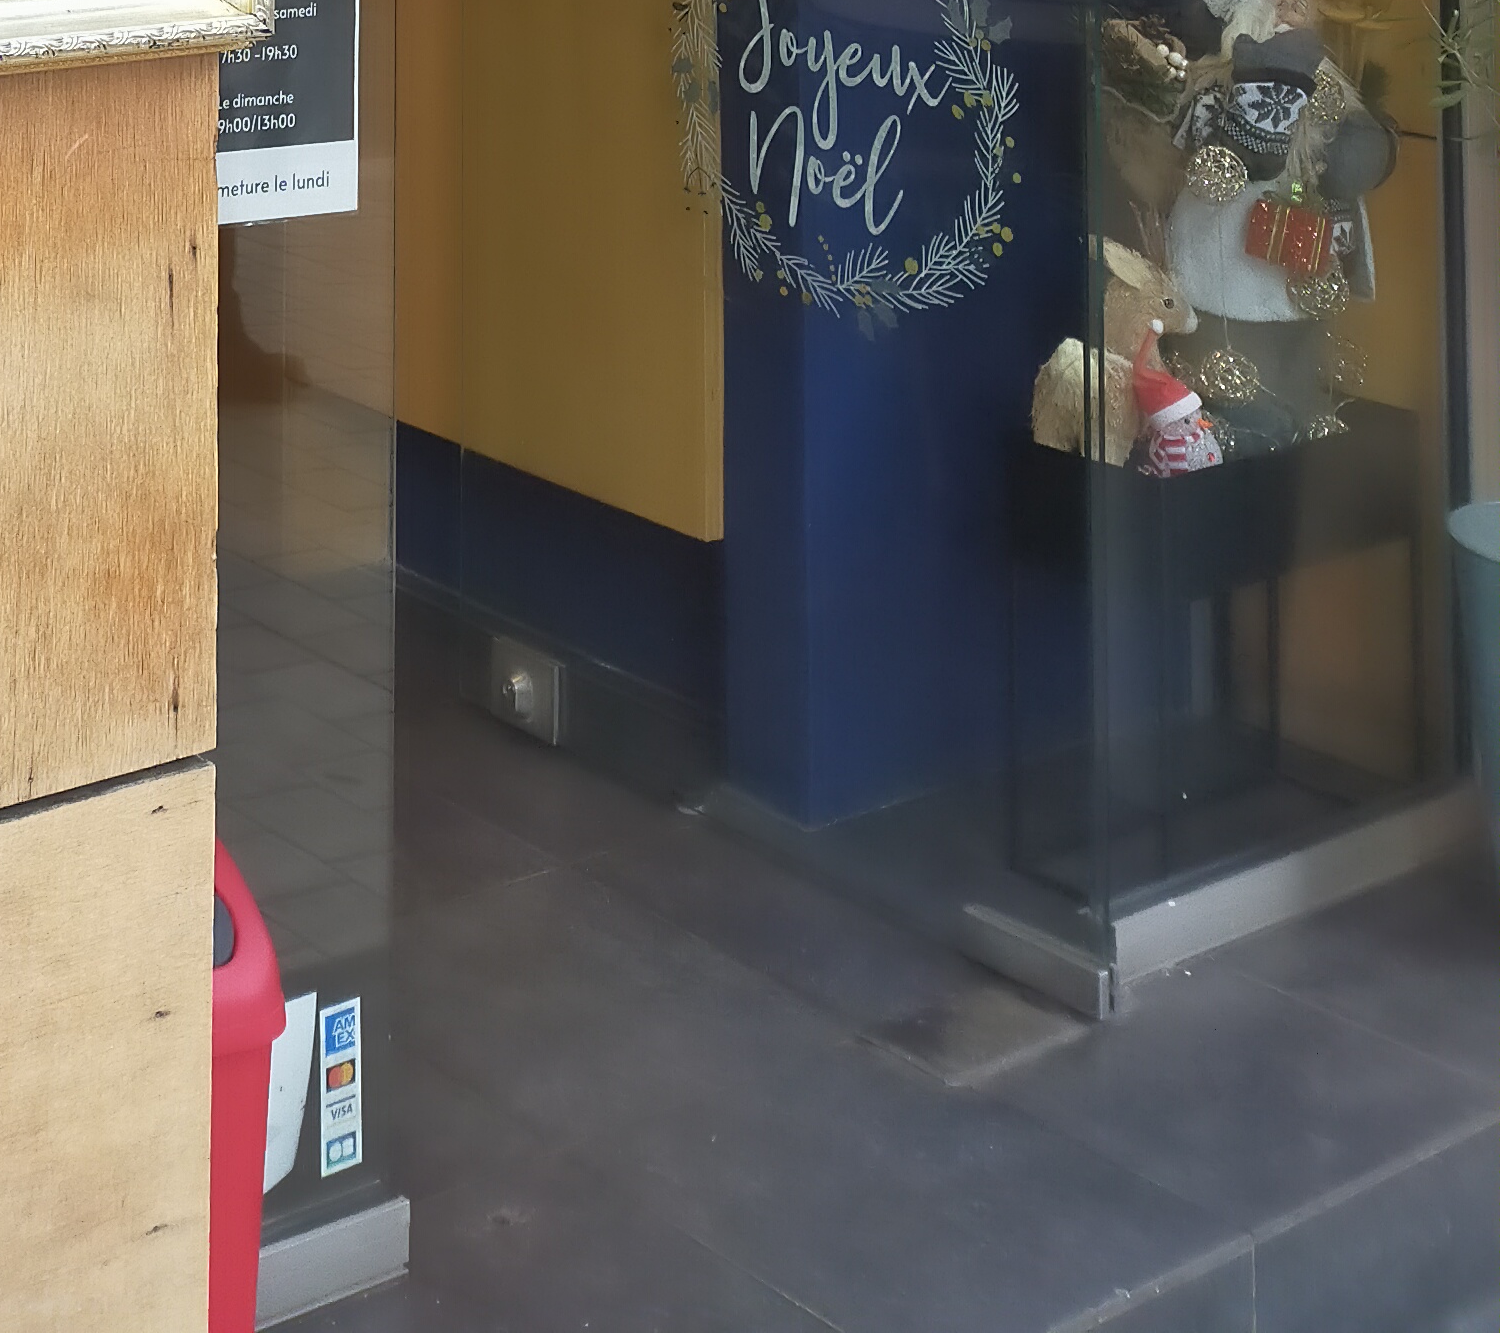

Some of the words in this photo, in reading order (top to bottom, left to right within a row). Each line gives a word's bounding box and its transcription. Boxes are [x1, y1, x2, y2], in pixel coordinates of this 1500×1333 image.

[273, 2, 318, 19] samedi
[232, 90, 294, 109] dimanche
[217, 112, 296, 135] 9h00/13h00
[749, 105, 904, 235] Noël
[217, 178, 270, 199] meture
[274, 173, 288, 193] le
[292, 170, 330, 191] lundi
[332, 1012, 356, 1034] AM
[330, 1102, 354, 1120] VISA
